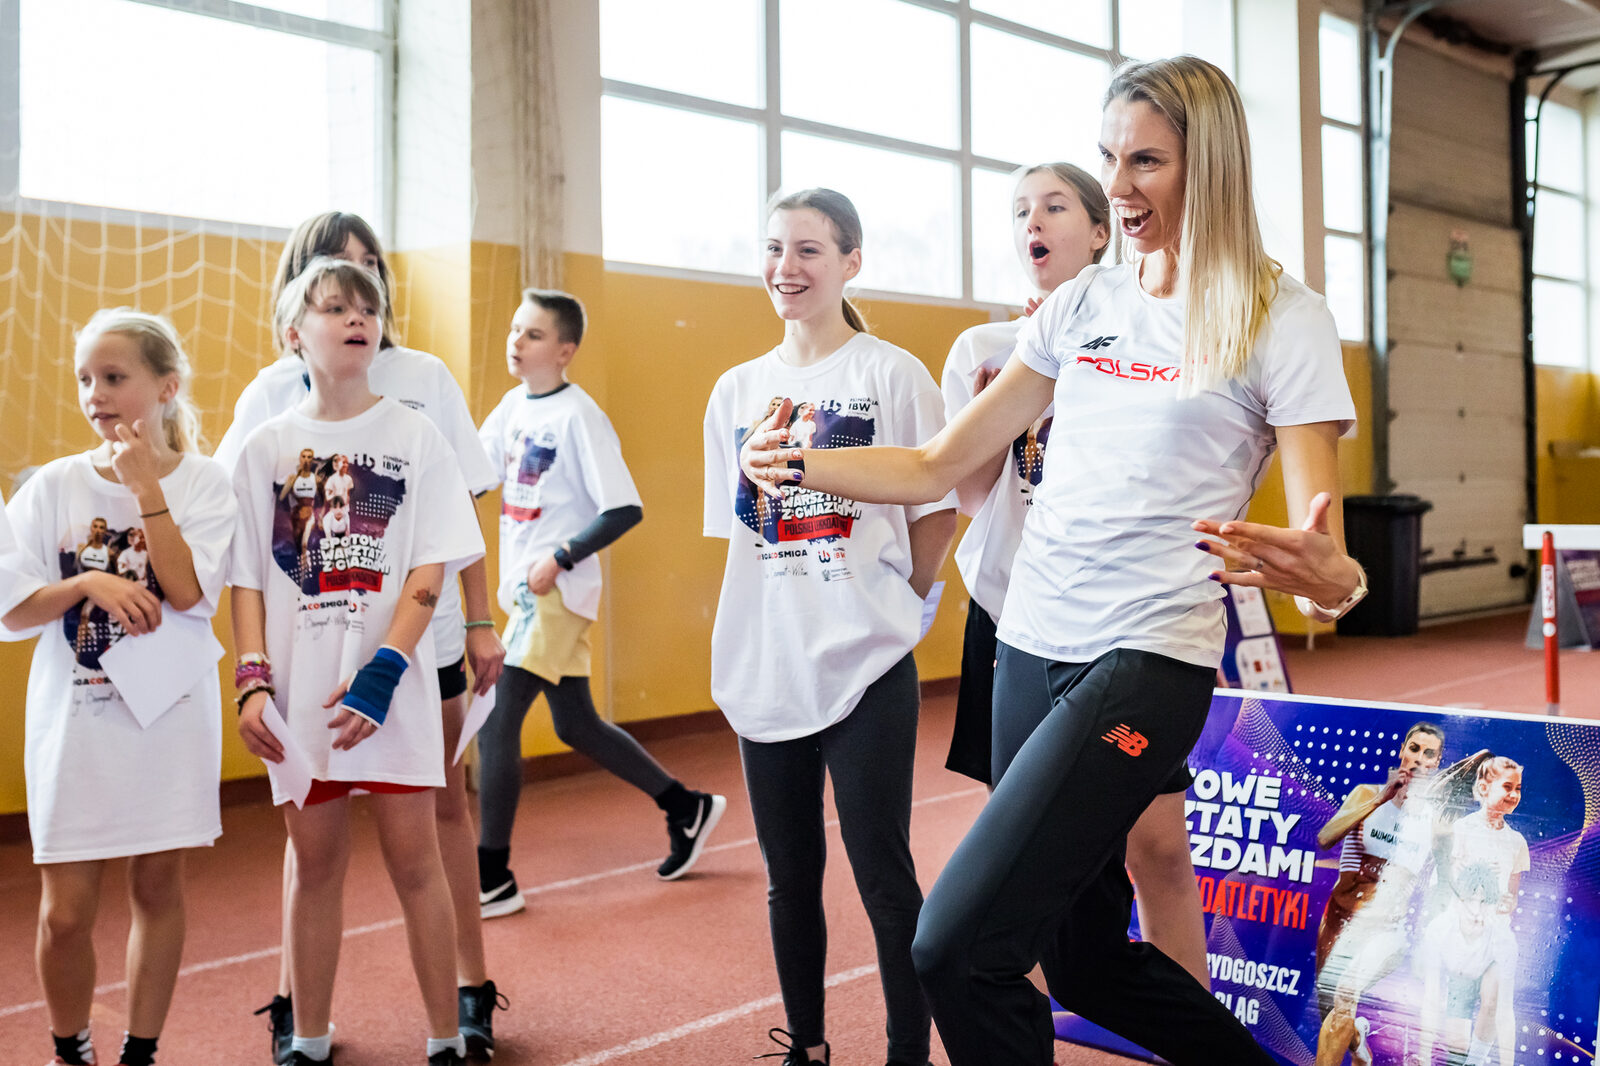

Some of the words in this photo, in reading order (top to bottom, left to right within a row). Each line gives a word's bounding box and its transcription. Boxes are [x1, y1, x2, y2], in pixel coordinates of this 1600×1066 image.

[848, 402, 871, 413] IBW
[383, 461, 402, 473] IBW
[1189, 767, 1283, 810] OWE
[1195, 875, 1310, 931] OATLETYKI
[1206, 952, 1301, 996] YDGOSZCZ
